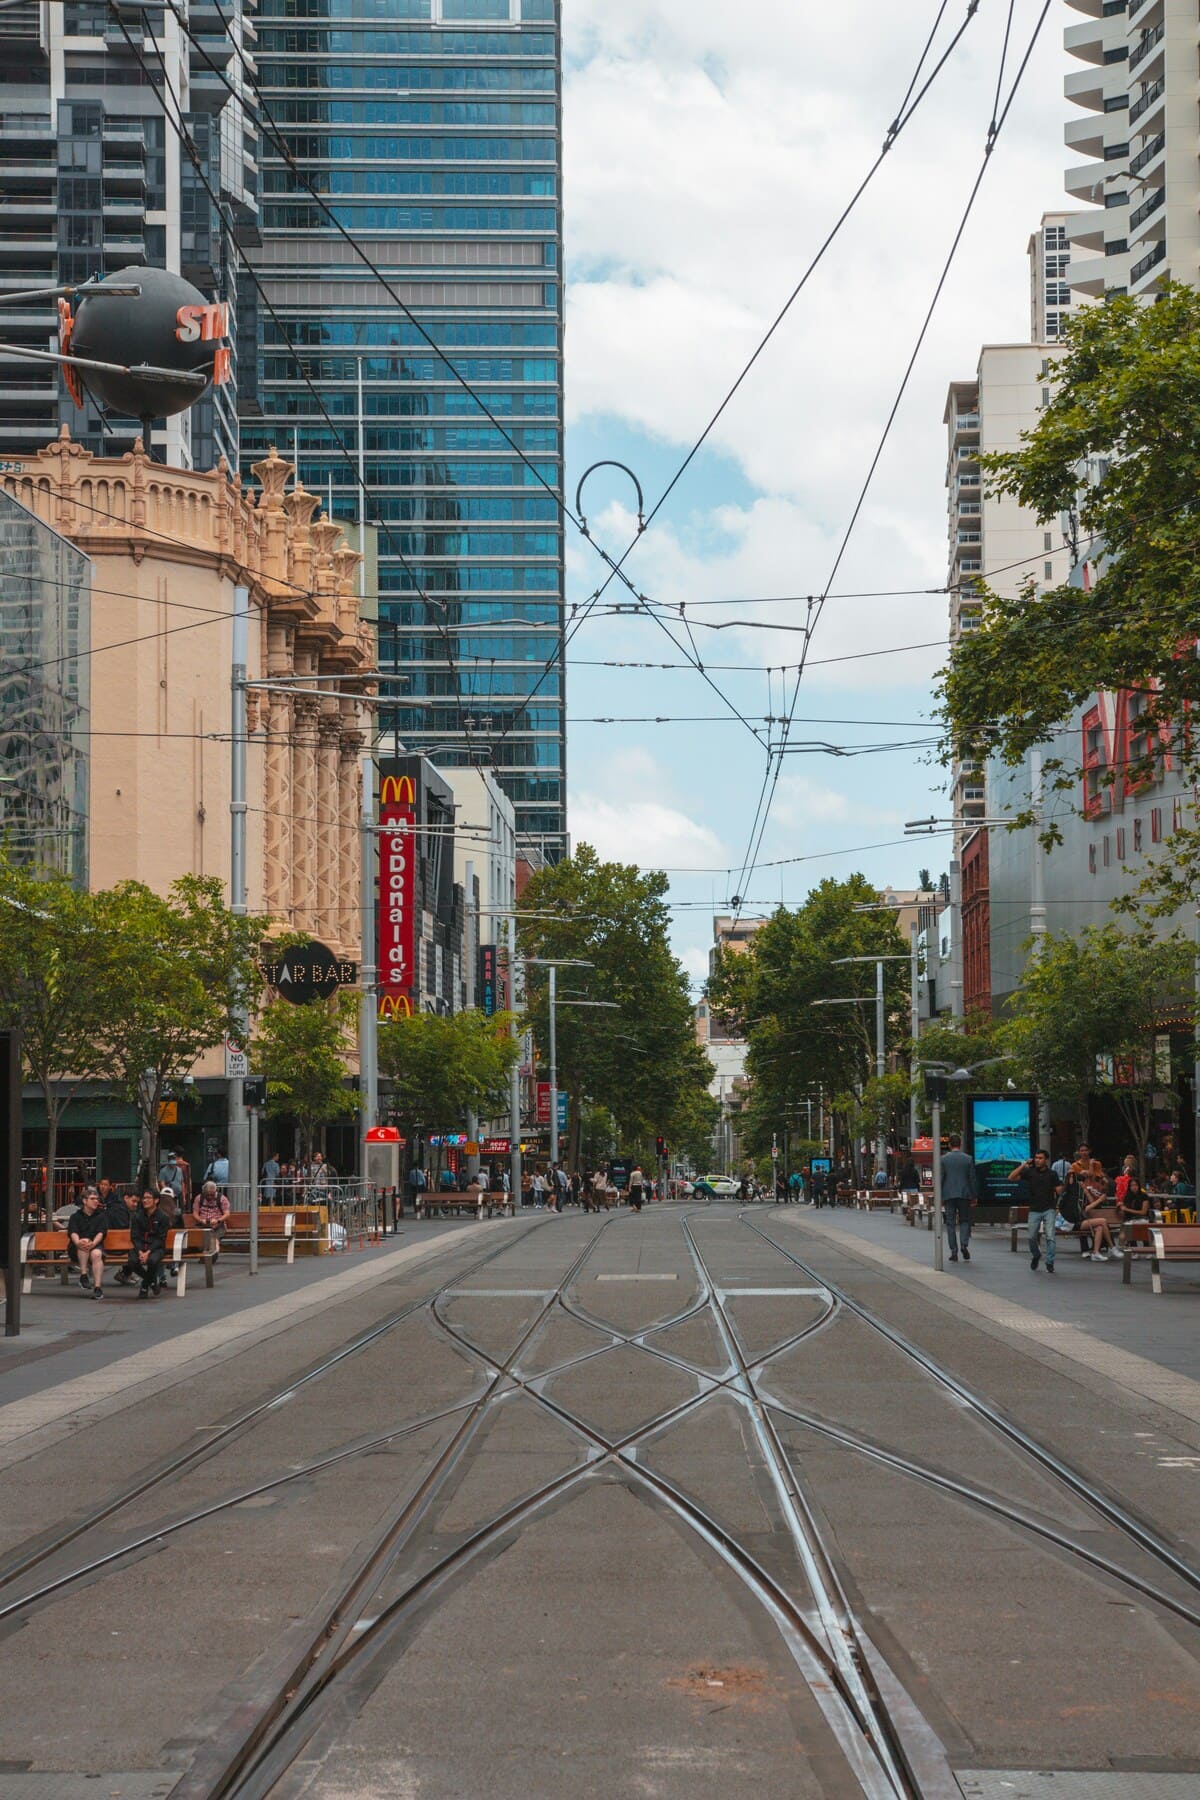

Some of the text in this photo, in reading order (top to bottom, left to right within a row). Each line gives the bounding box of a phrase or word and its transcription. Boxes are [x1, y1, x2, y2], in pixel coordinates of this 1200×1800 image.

[385, 817, 409, 983] McDonald's
[312, 964, 353, 983] BAR
[230, 1054, 244, 1062] NO
